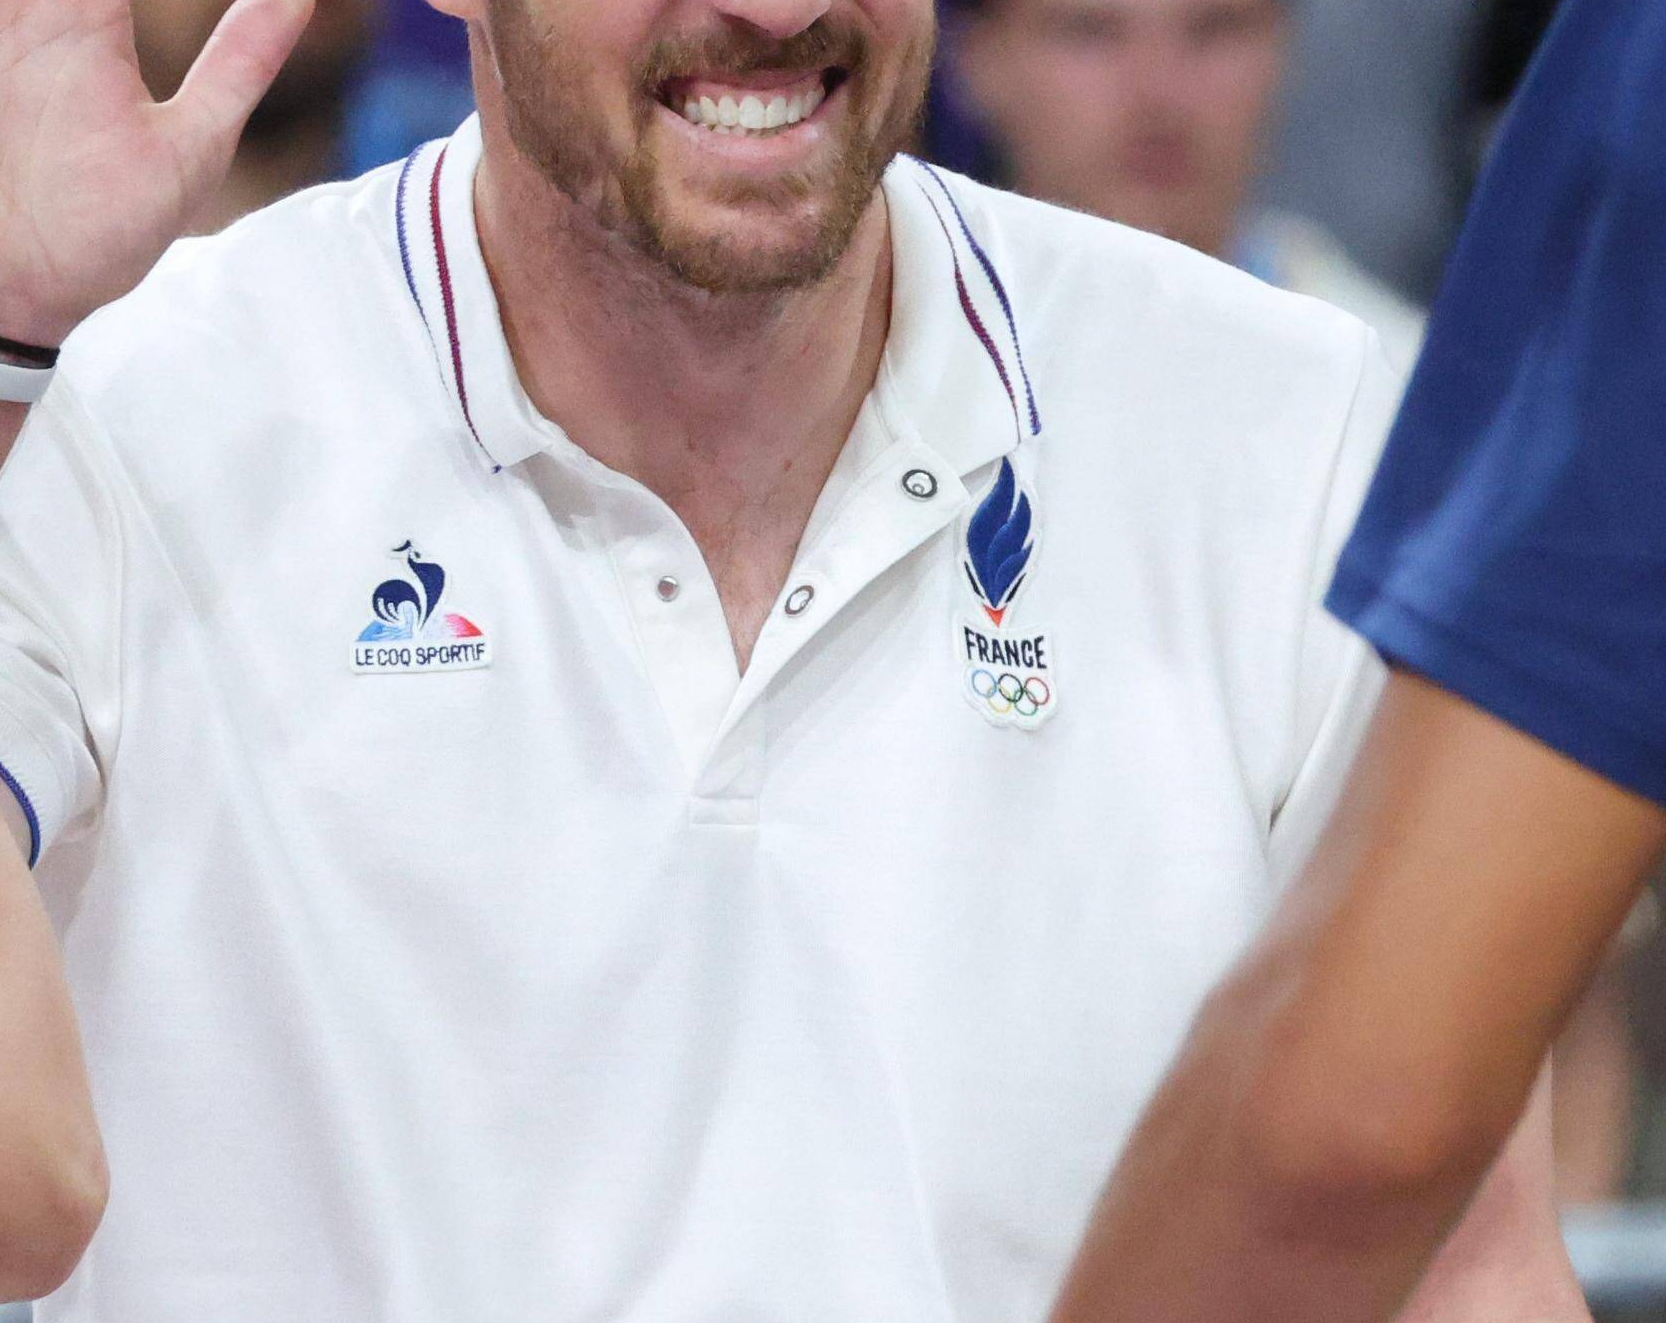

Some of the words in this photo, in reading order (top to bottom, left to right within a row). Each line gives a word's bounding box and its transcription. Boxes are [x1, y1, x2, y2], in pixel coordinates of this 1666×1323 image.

[355, 648, 374, 666] LE
[377, 648, 411, 666] COQ
[416, 643, 485, 665] SPORTIF
[964, 626, 1047, 669] FRANCE
